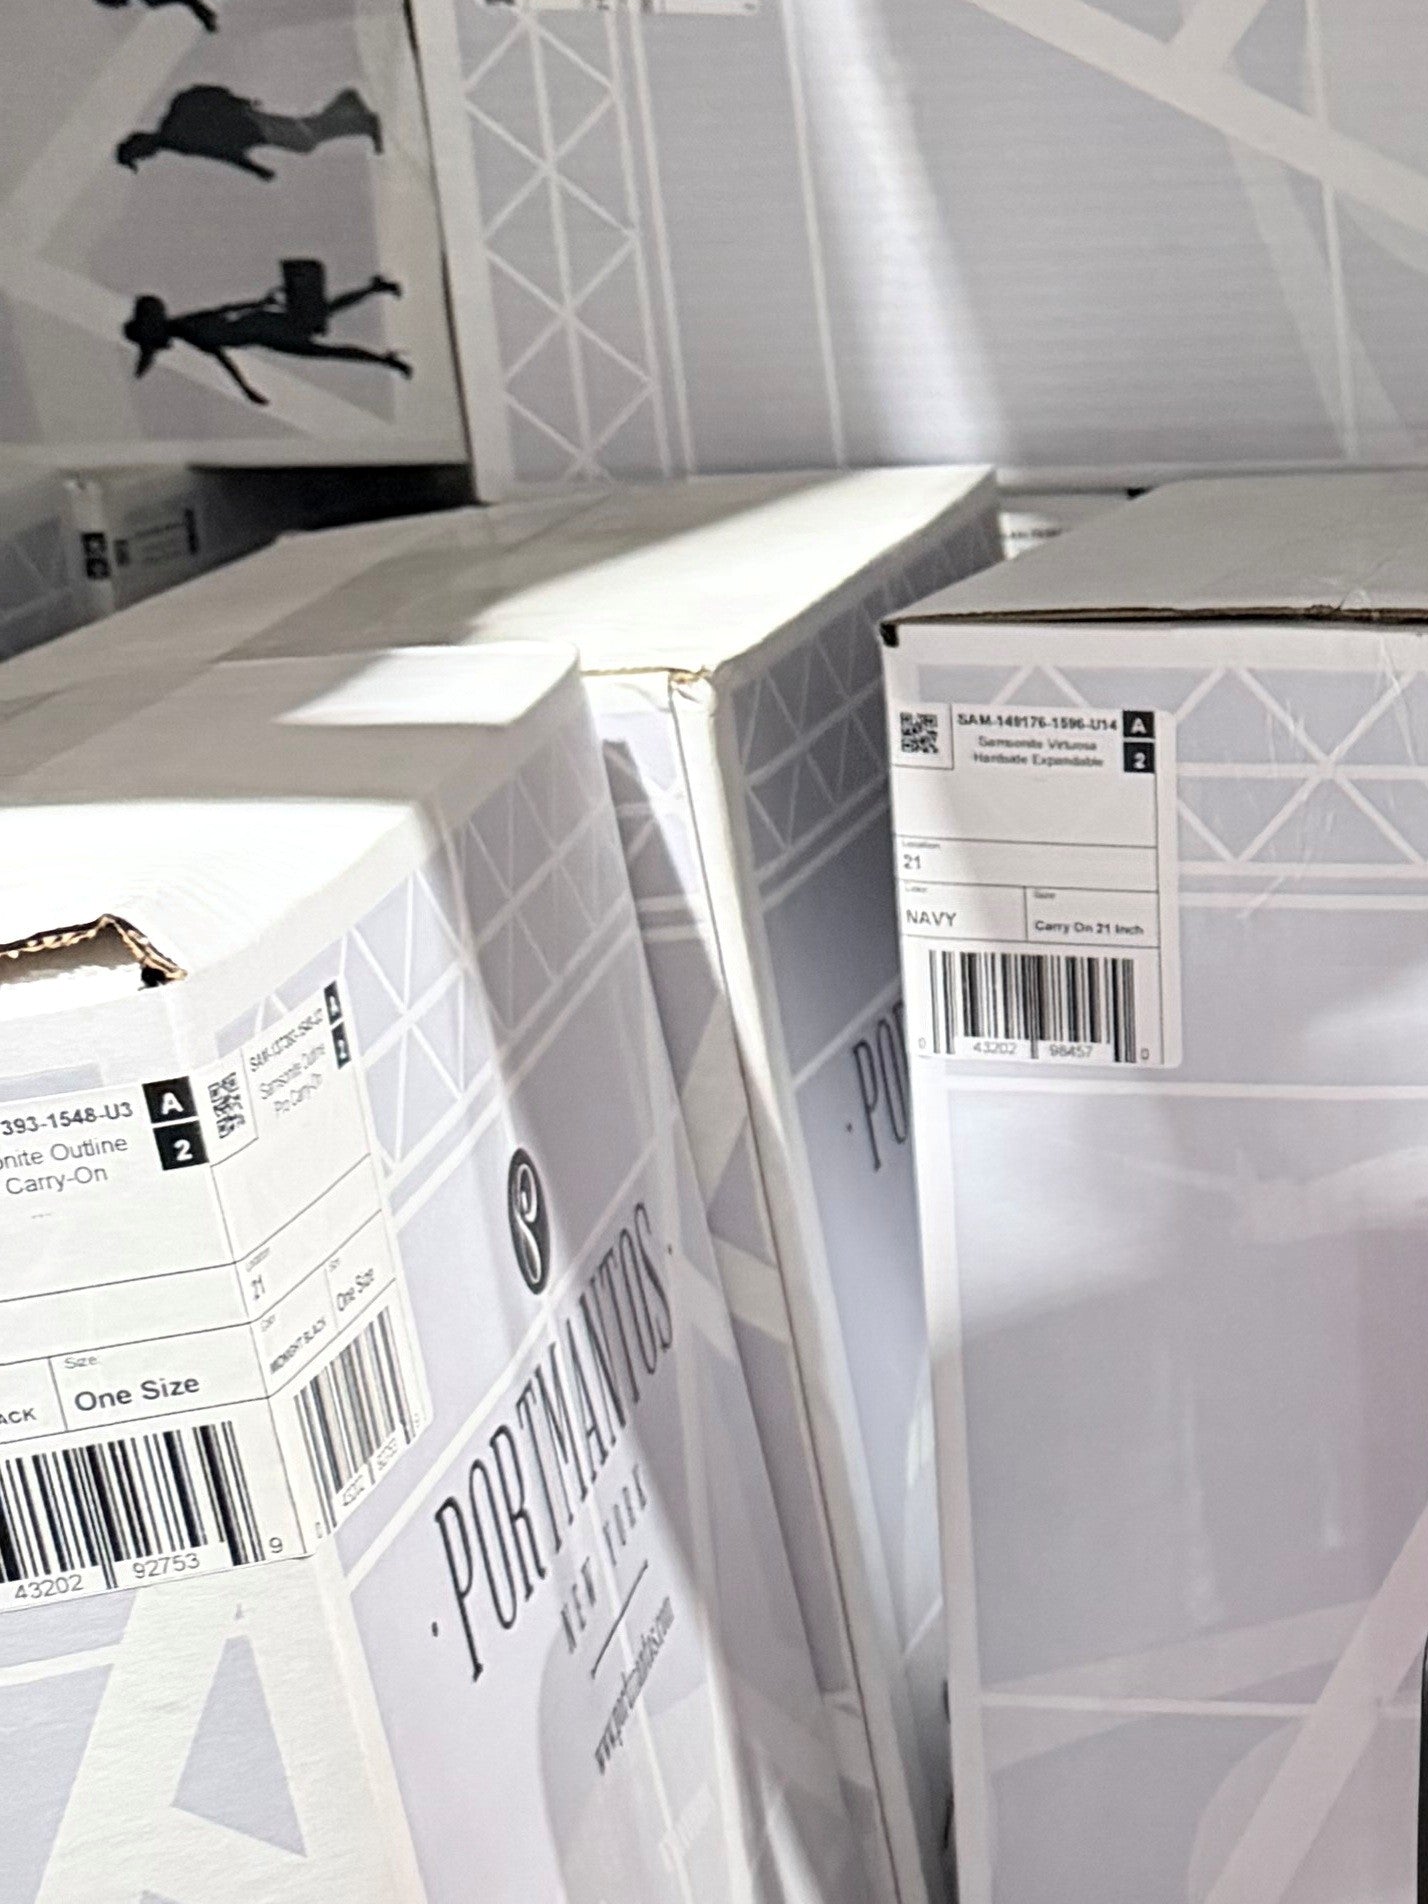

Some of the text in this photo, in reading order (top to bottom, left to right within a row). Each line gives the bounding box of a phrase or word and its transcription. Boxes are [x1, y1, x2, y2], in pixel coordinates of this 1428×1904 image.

[1130, 717, 1147, 734] A
[1133, 752, 1147, 769] 2
[903, 853, 922, 870] 21
[906, 908, 957, 927] NAVY
[1035, 920, 1070, 935] Carry
[161, 1091, 184, 1116] A
[50, 1137, 129, 1161] Outline
[173, 1139, 194, 1162] 2
[6, 1166, 109, 1195] Carry-On
[74, 1377, 201, 1412] One Size
[433, 1201, 674, 1683] PORTMANTOS
[15, 1536, 284, 1600] 43202 92753 9
